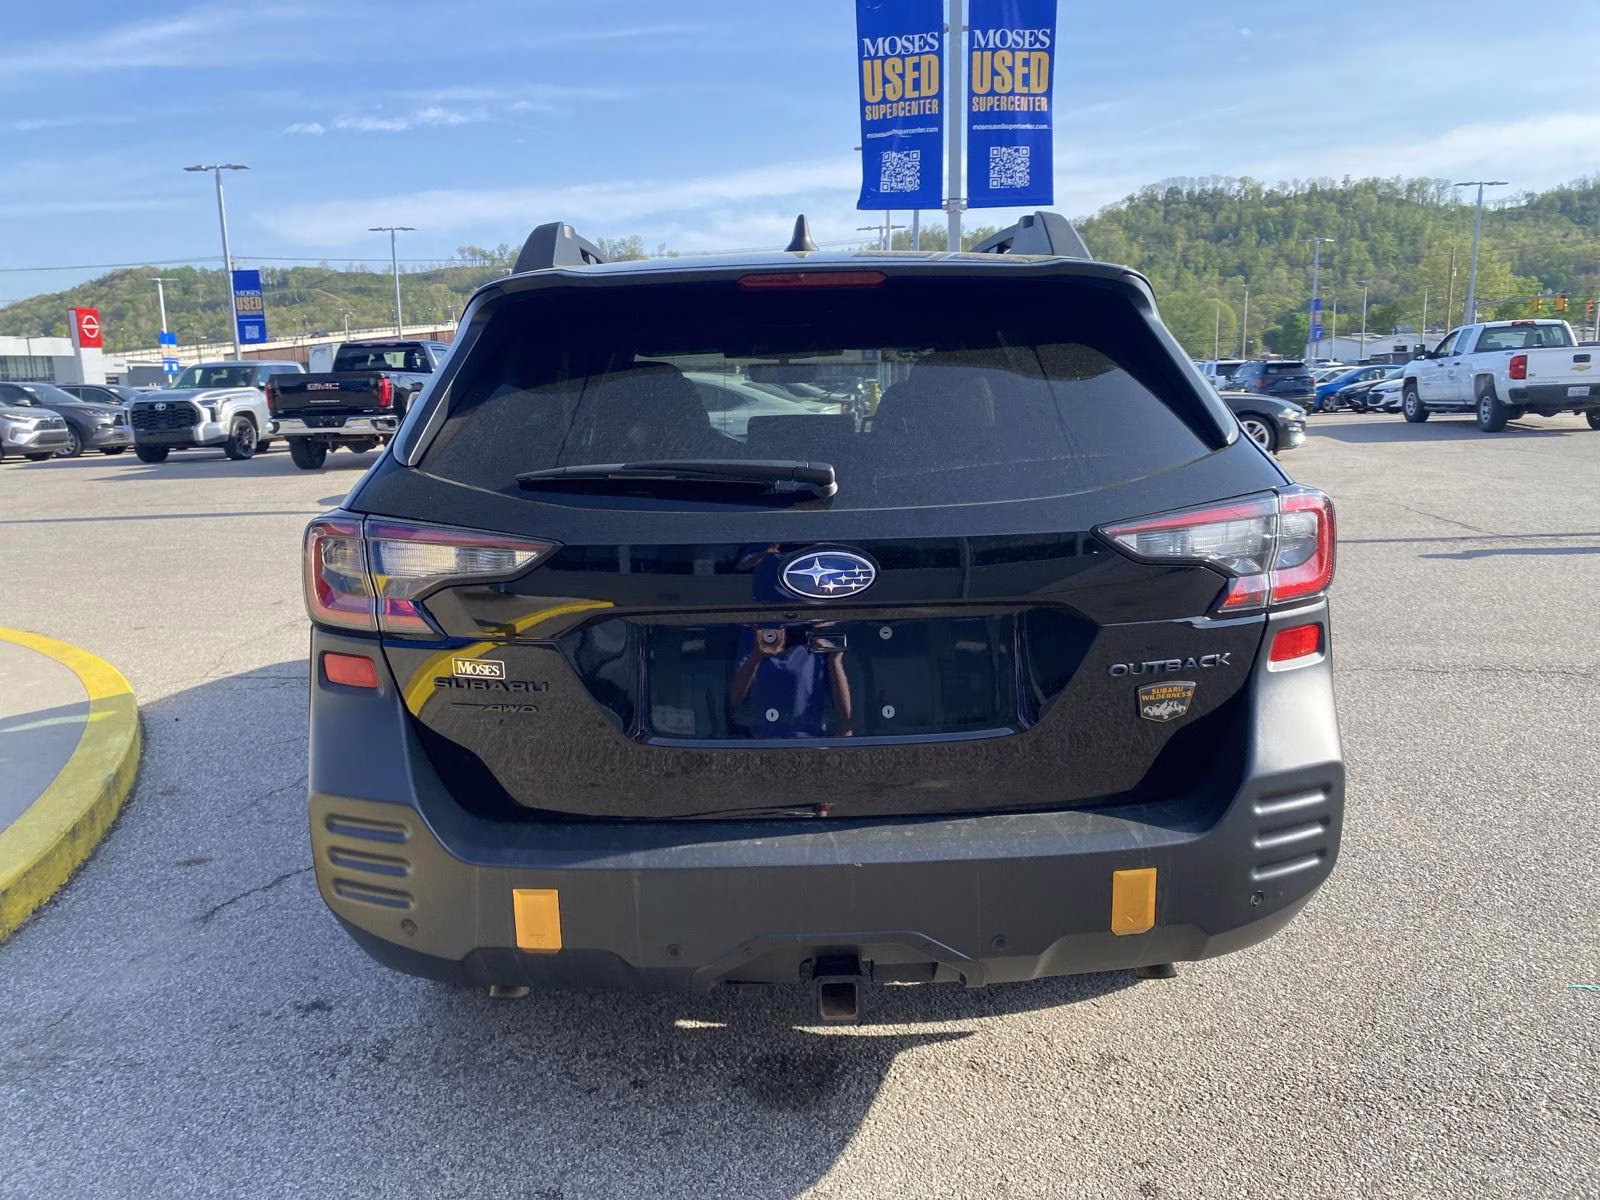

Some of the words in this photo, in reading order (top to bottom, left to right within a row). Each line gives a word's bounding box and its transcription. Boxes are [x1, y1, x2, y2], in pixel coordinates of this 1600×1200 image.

[862, 32, 939, 57] MOSES
[973, 28, 1050, 49] MOSES
[862, 54, 940, 103] USED
[971, 50, 1050, 95] USED
[865, 99, 939, 121] SUPERCENTER
[972, 96, 1048, 112] SUPERCENTER
[236, 297, 263, 310] USED
[306, 382, 340, 390] GMC
[1108, 652, 1231, 678] OUTBACK
[434, 677, 549, 692] SUBARU
[1151, 686, 1184, 696] SUBARU
[1141, 690, 1193, 701] WILDERNESS
[483, 703, 539, 713] AWD
